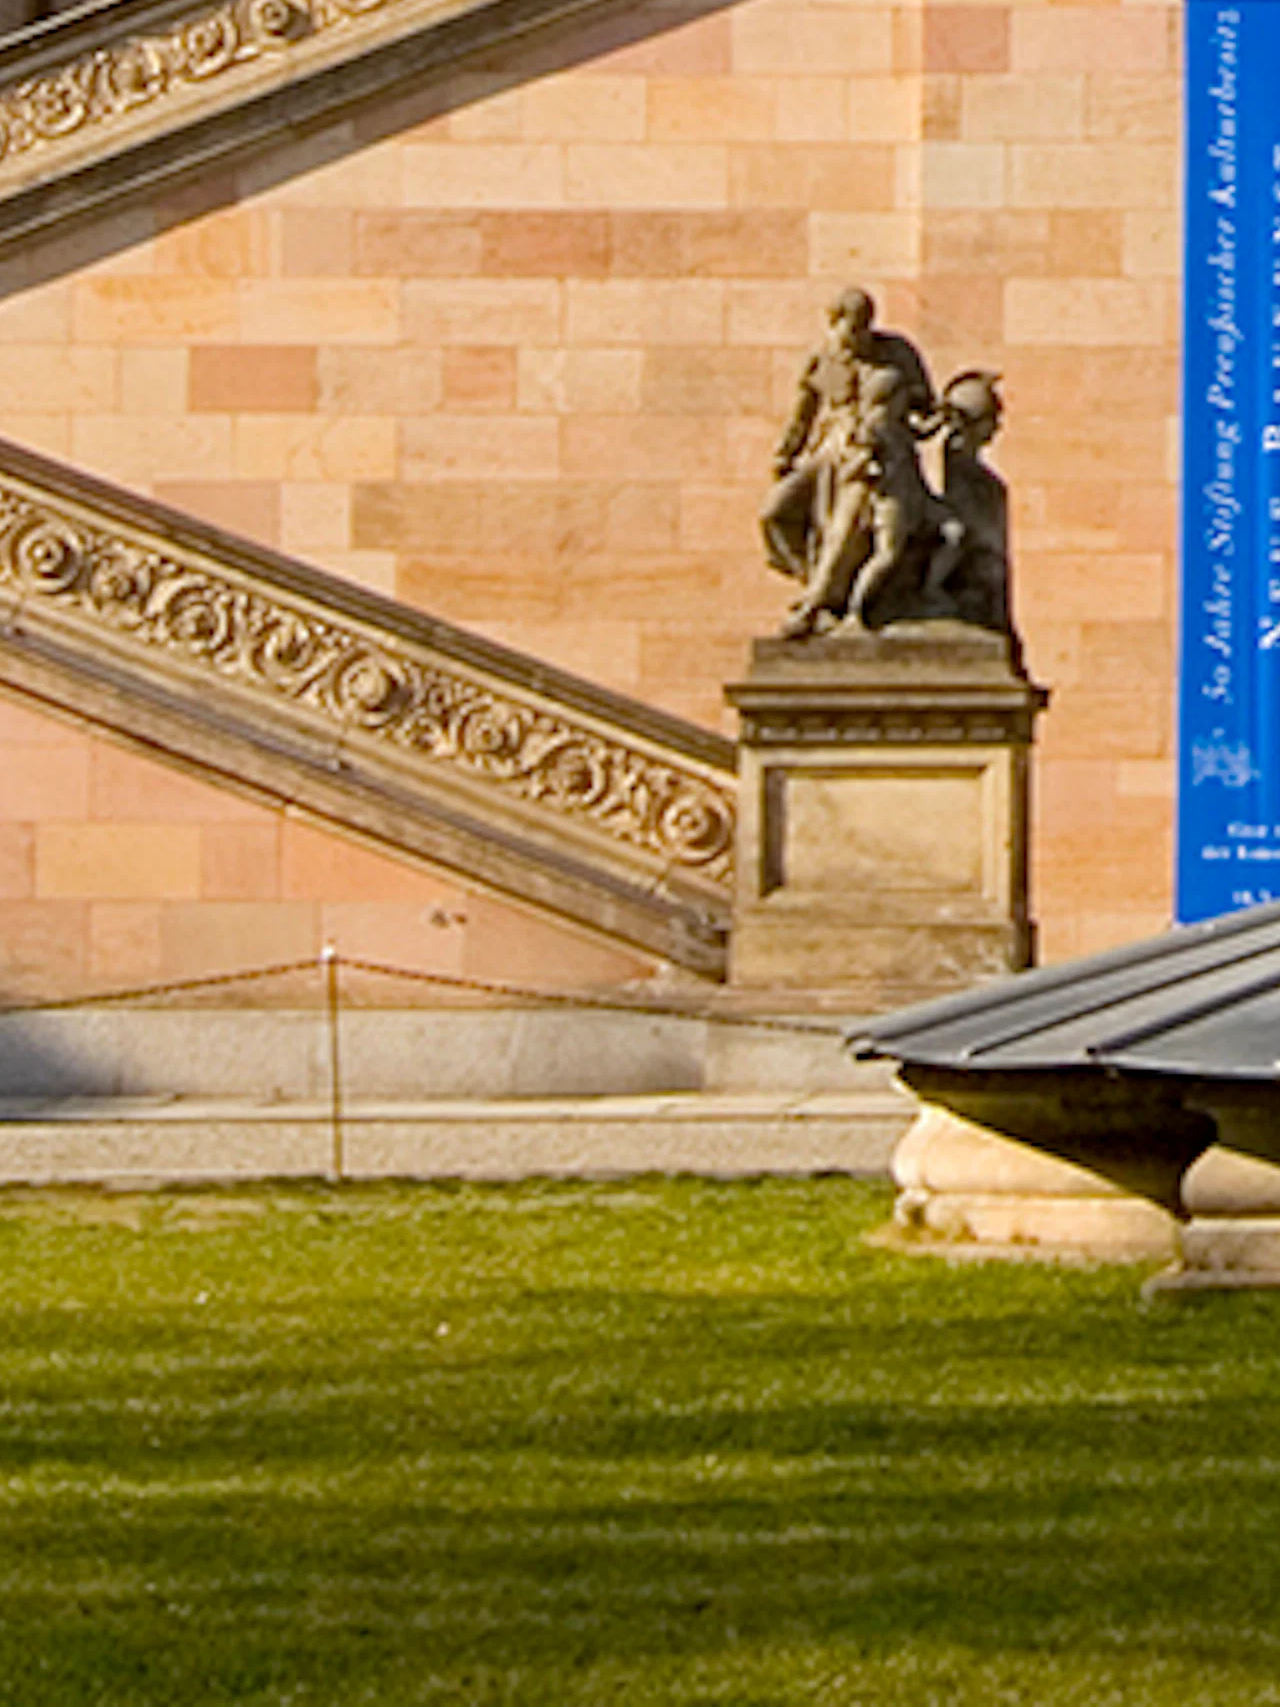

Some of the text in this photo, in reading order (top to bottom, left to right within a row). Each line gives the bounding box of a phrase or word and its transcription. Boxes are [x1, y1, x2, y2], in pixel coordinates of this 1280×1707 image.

[1208, 8, 1240, 208] Kulturbesitz
[1204, 420, 1241, 556] Stiftung
[1203, 564, 1232, 657] Jahre
